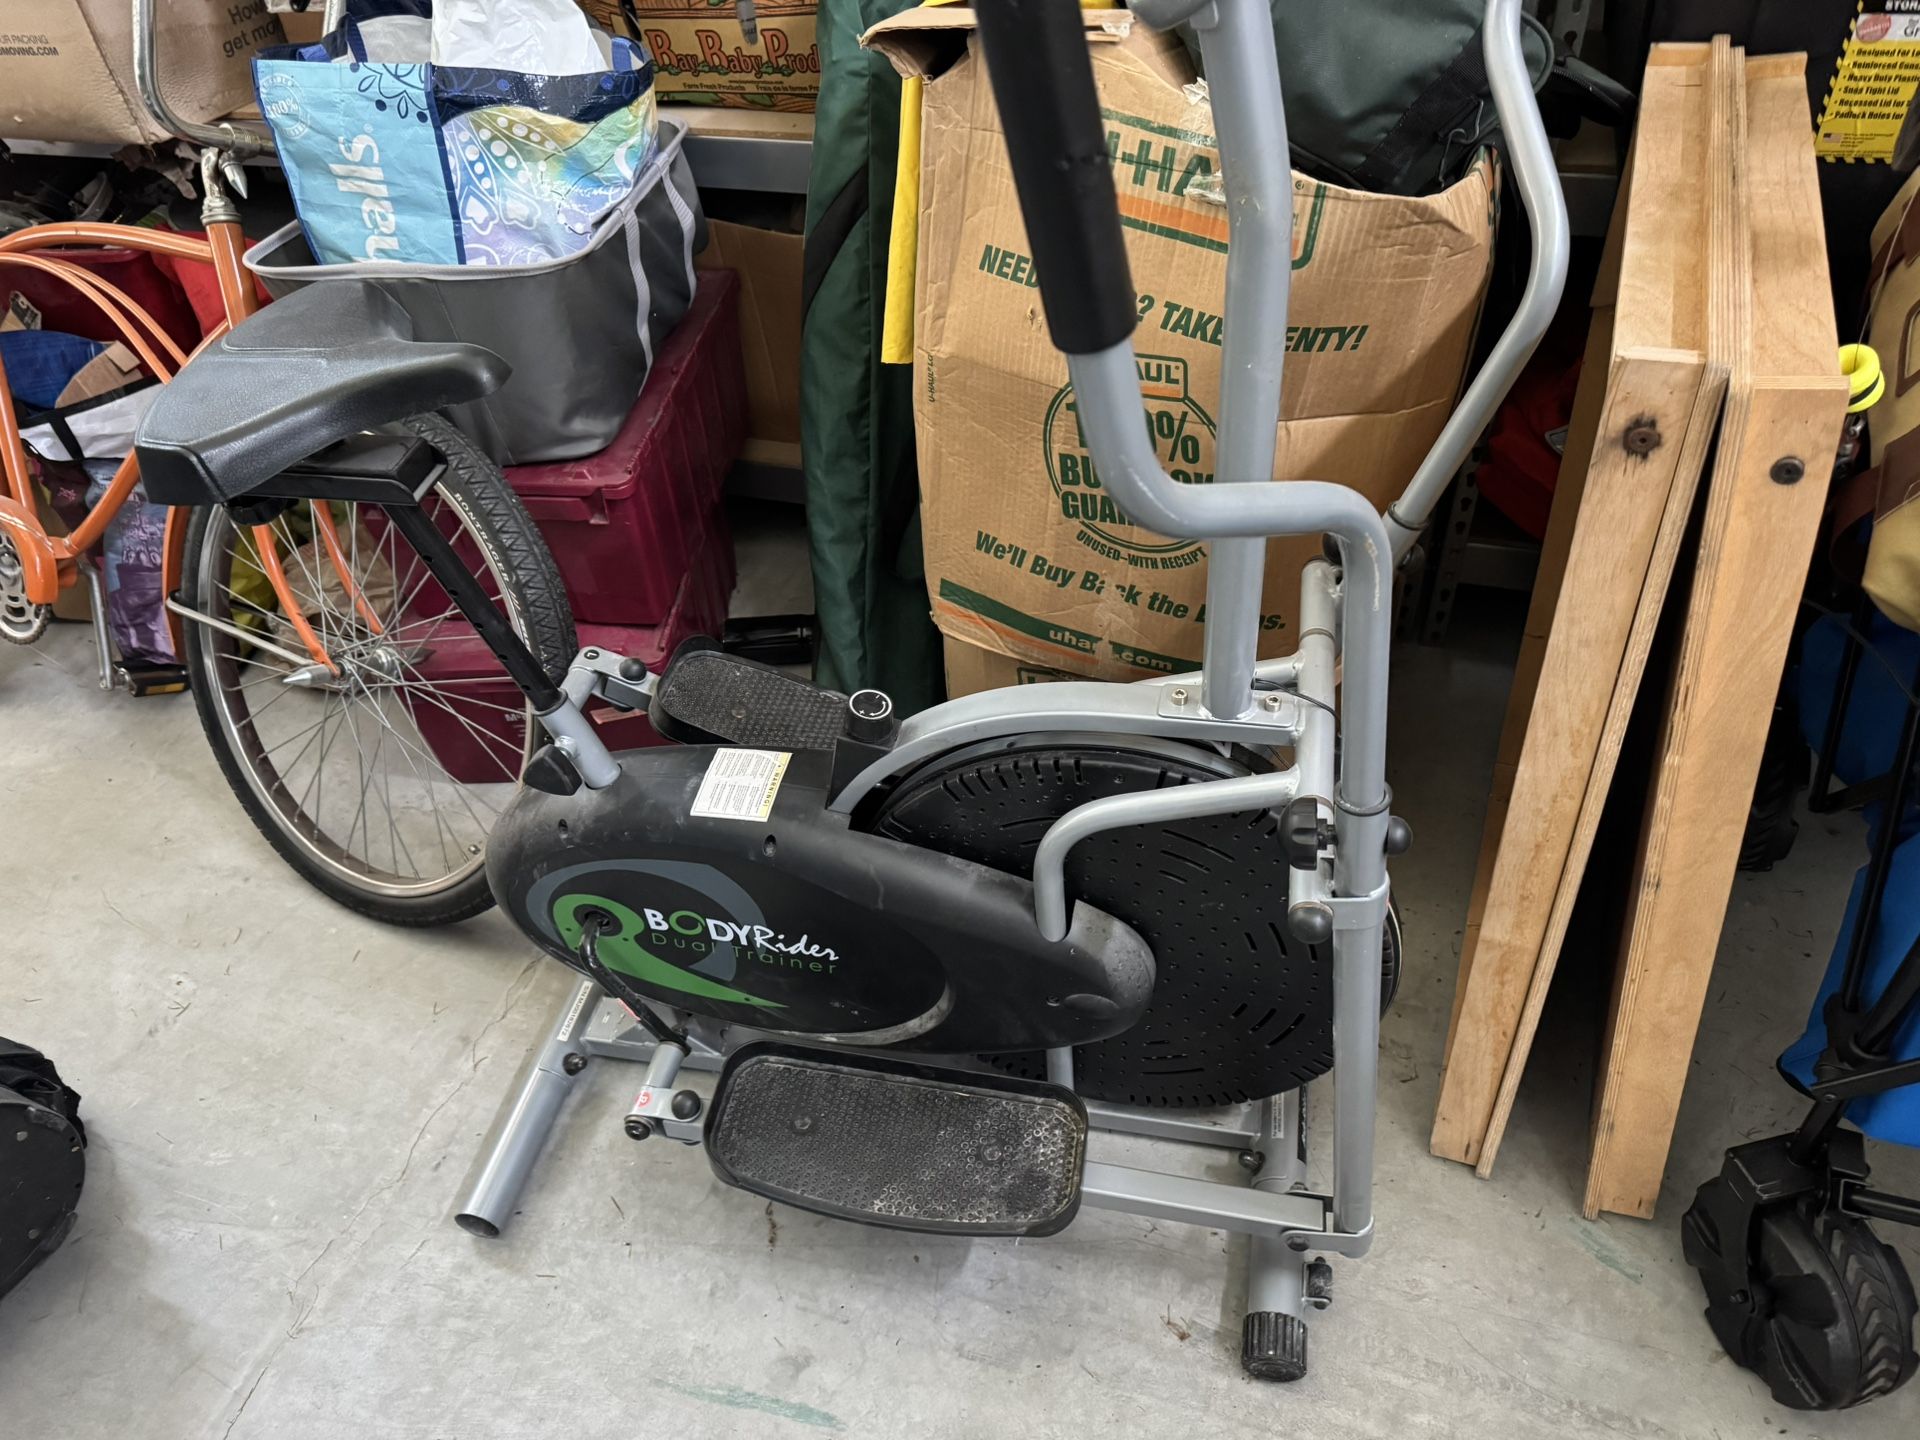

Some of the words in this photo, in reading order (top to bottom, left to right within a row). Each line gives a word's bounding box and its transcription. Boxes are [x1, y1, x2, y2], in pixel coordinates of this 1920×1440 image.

[223, 30, 250, 58] get
[251, 21, 277, 42] mo
[760, 28, 820, 73] Prod
[1856, 48, 1896, 57] Designed
[1847, 73, 1873, 82] Heavy
[1873, 73, 1893, 83] Duty
[1852, 61, 1898, 70] Reinforced
[1843, 86, 1864, 95] Snap
[1865, 86, 1887, 95] Tight
[1887, 86, 1900, 95] Lid
[1834, 111, 1867, 120] Padlock
[1867, 111, 1891, 120] Holes
[1838, 99, 1879, 108] Recessed
[1284, 325, 1369, 353] ENTY!
[453, 492, 510, 582] BONTRAGER
[1161, 547, 1208, 570] RECEIPT
[975, 530, 1027, 569] We'll
[1029, 554, 1076, 588] Buy
[1149, 592, 1189, 619] the
[763, 771, 781, 807] WARNING!
[652, 932, 716, 954] Dual
[732, 944, 838, 975] Trainer
